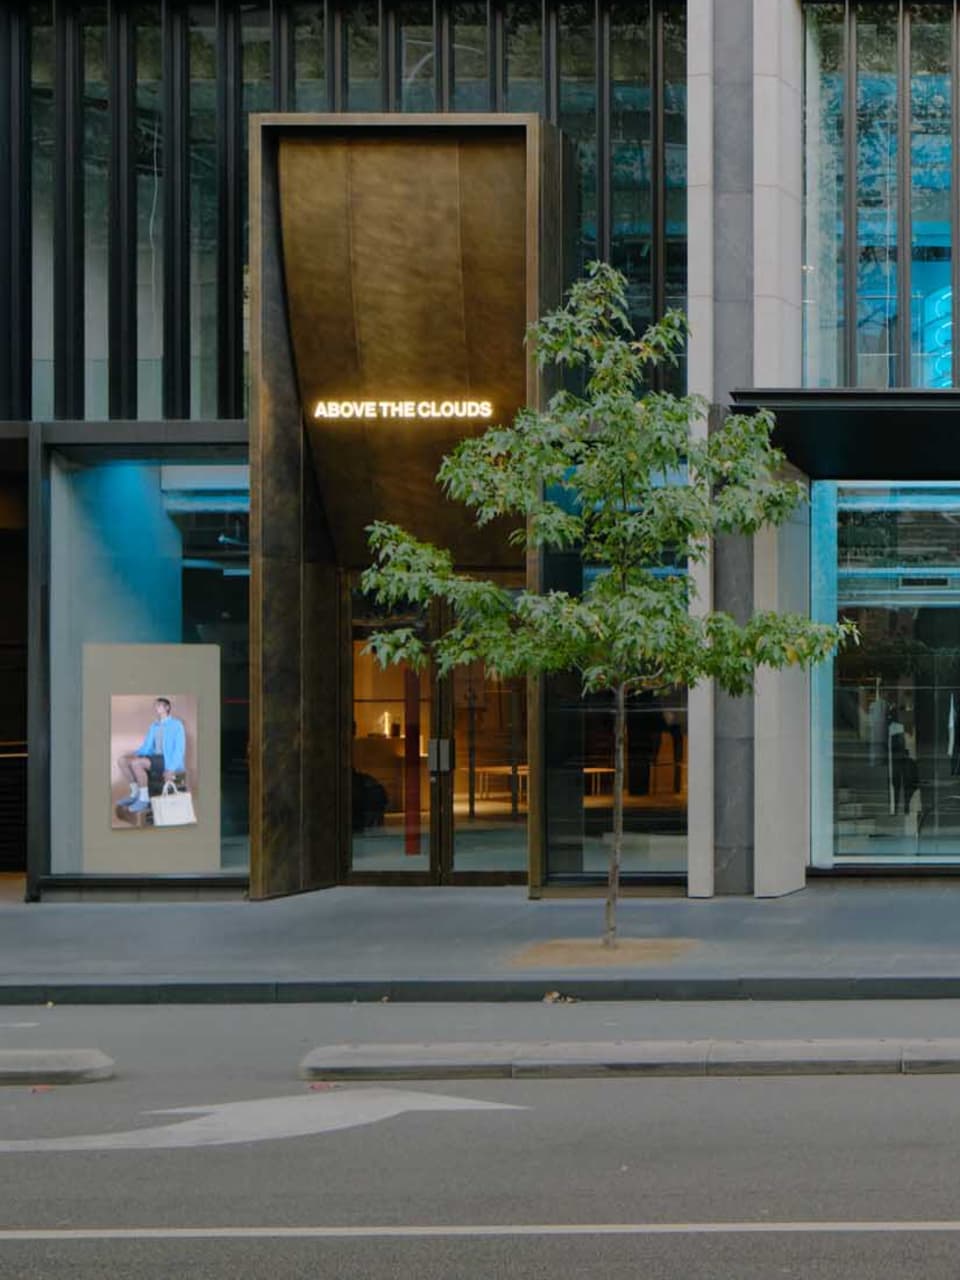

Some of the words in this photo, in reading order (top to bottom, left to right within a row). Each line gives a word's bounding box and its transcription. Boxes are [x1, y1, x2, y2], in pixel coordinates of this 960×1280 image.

[314, 401, 377, 418] ABOVE
[379, 401, 415, 418] THE
[417, 401, 493, 418] CLOUDS
